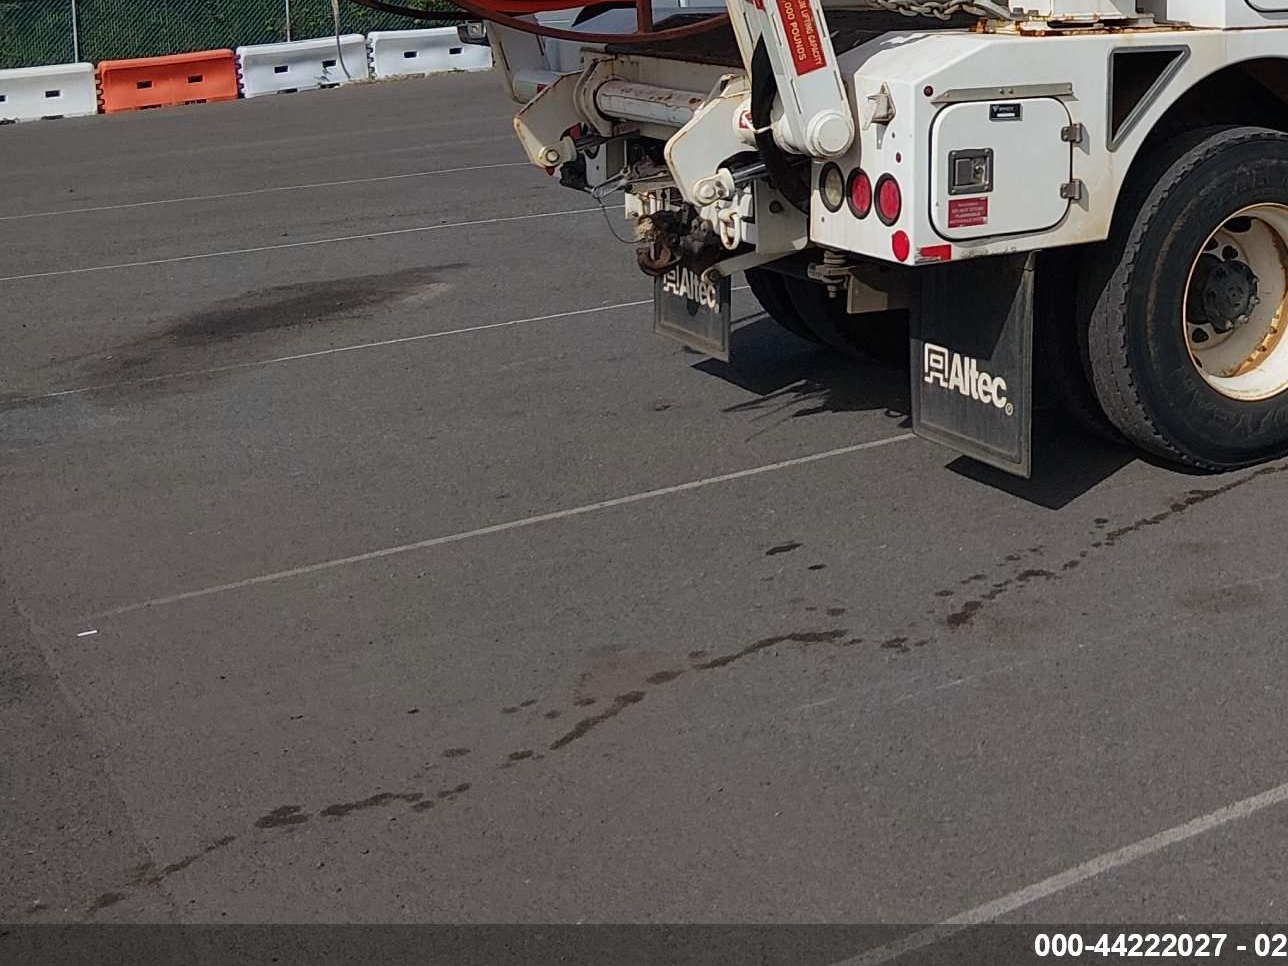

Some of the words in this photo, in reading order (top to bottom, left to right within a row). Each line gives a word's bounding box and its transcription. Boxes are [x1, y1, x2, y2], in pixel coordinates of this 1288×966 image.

[790, 21, 807, 61] POUNDS
[800, 9, 814, 34] LIFTING
[807, 34, 822, 65] CAPACITY
[679, 267, 716, 308] Altec
[948, 352, 1007, 409] Altec
